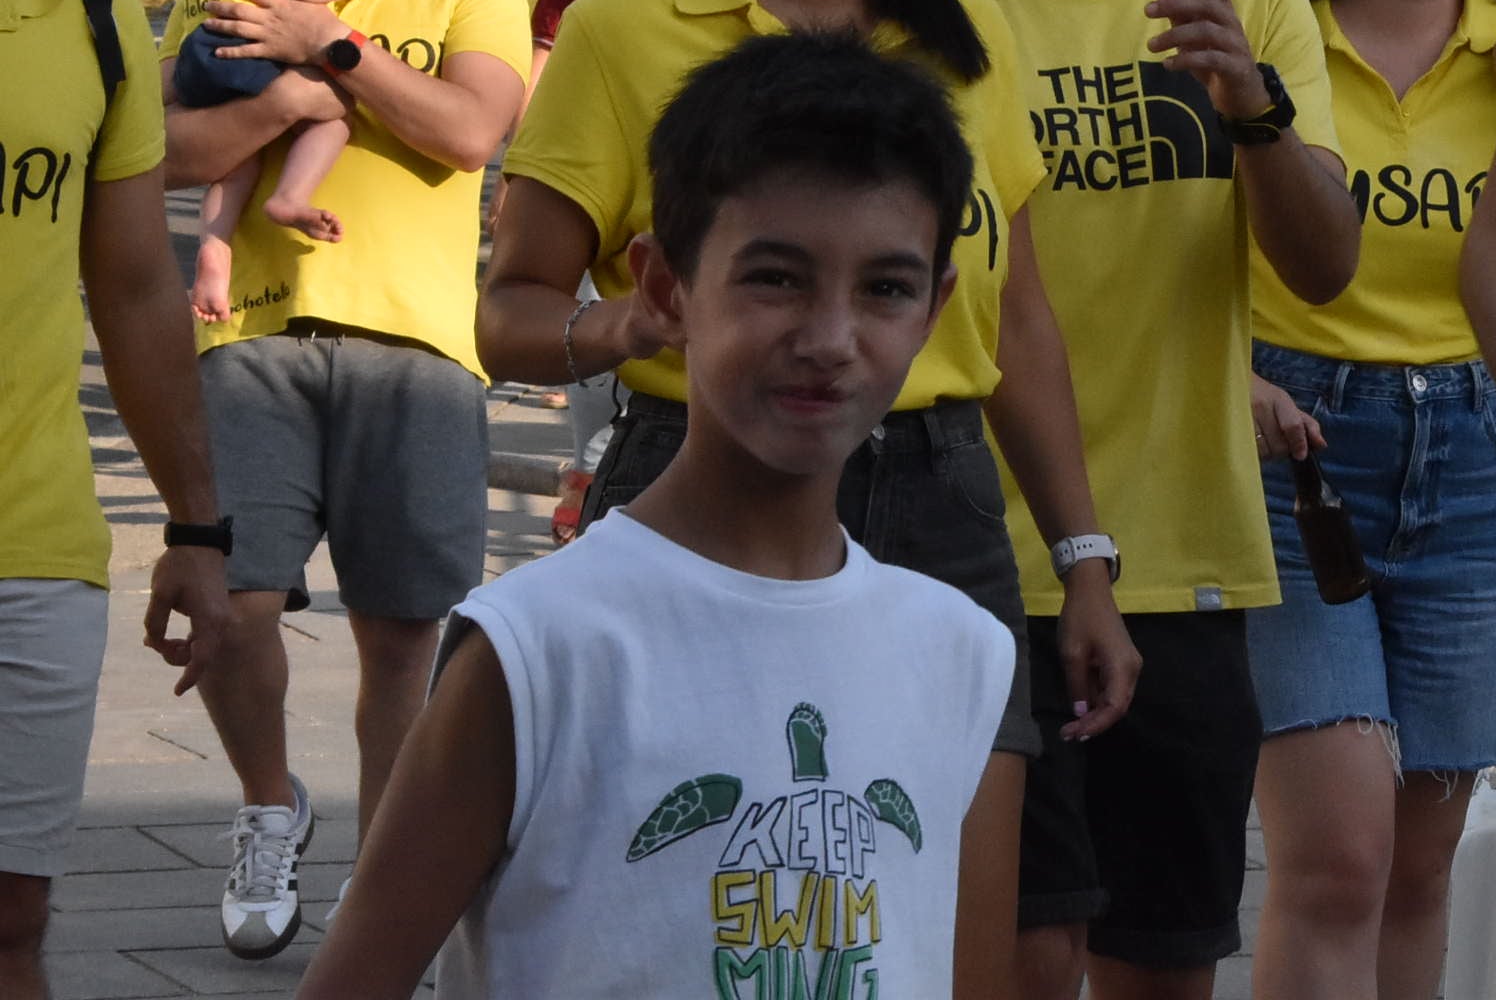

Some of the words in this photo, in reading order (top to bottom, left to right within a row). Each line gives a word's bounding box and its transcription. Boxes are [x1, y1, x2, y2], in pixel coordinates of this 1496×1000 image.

[1037, 63, 1139, 104] THE
[719, 788, 876, 880] KEEP
[711, 868, 882, 952] SWIM
